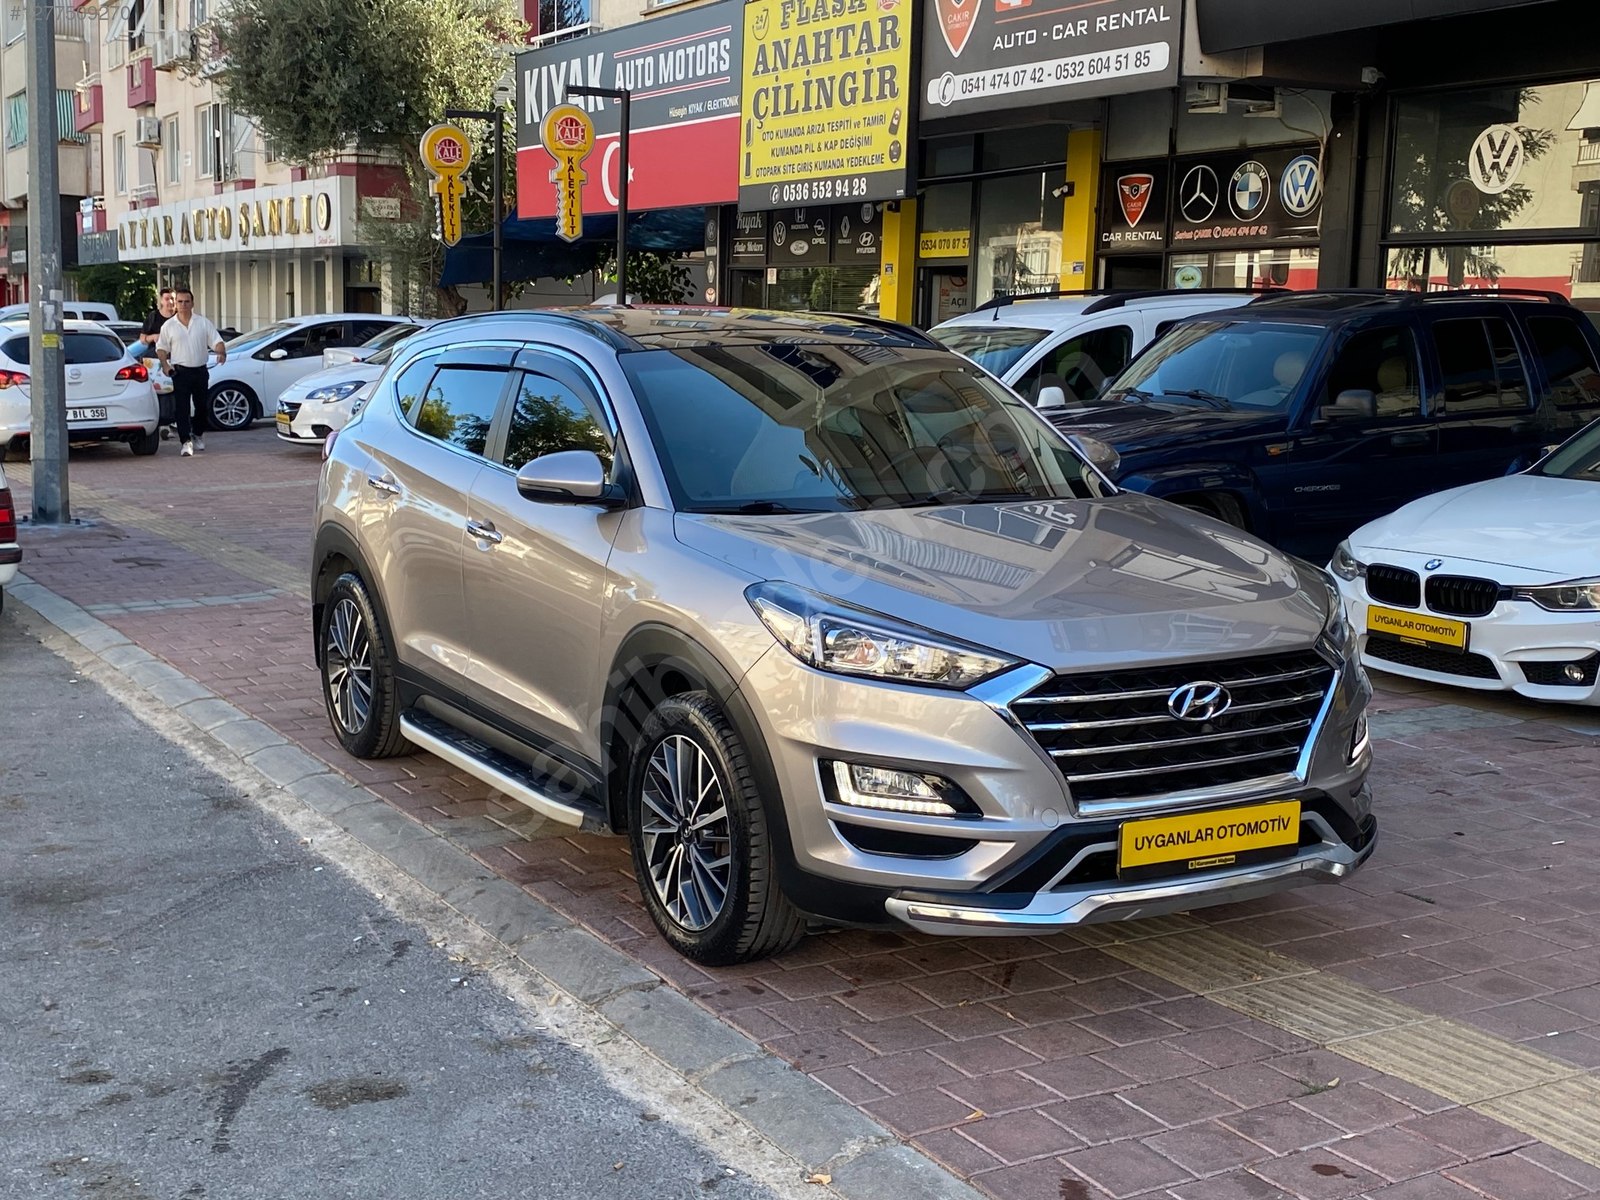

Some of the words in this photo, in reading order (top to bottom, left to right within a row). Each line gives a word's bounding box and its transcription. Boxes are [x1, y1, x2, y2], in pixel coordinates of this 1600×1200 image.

[992, 29, 1037, 50] AUTO
[1052, 19, 1088, 41] CAR
[1095, 5, 1171, 33] RENTAL
[752, 14, 901, 76] ANAHTAR
[614, 55, 654, 91] AUTO
[659, 38, 731, 85] MOTORS
[961, 78, 985, 95] 0541
[990, 73, 1010, 90] 474
[1013, 70, 1027, 87] 07
[1030, 67, 1044, 84] 42
[1055, 60, 1084, 81] 0532
[1088, 55, 1111, 75] 604
[1114, 52, 1129, 72] 51
[1134, 50, 1150, 68] 85
[525, 52, 604, 125] KIYAK
[752, 58, 899, 129] ÇİLİNGİR
[555, 125, 586, 141] KALE
[762, 131, 774, 141] OTO
[775, 126, 805, 140] KUMANDA
[806, 123, 825, 135] ARIZA
[827, 118, 852, 132] TESPİTİ
[853, 121, 861, 129] ve
[435, 145, 463, 160] KALE
[771, 145, 803, 158] KUMANDA
[817, 143, 822, 152] &
[824, 140, 838, 151] KAP
[755, 165, 782, 178] OTOPARK
[814, 157, 845, 171] KUMANDA
[846, 153, 885, 168] YEDEKLEME
[783, 183, 809, 202] 0536
[812, 181, 832, 200] 552
[835, 178, 849, 197] 94
[852, 177, 867, 196] 28
[180, 205, 232, 244] AUTO
[1102, 232, 1121, 242] CAR
[1125, 231, 1162, 242] RENTAL
[921, 239, 936, 250] 0534
[938, 239, 950, 250] 070
[952, 238, 960, 249] 87
[73, 410, 88, 419] BIL
[90, 409, 105, 418] 356
[1374, 614, 1414, 630] UYGANLAR
[1415, 622, 1457, 637] OTOMOTİV
[1134, 828, 1213, 851] UYGANLAR
[1217, 815, 1291, 839] OTOMOTİV
